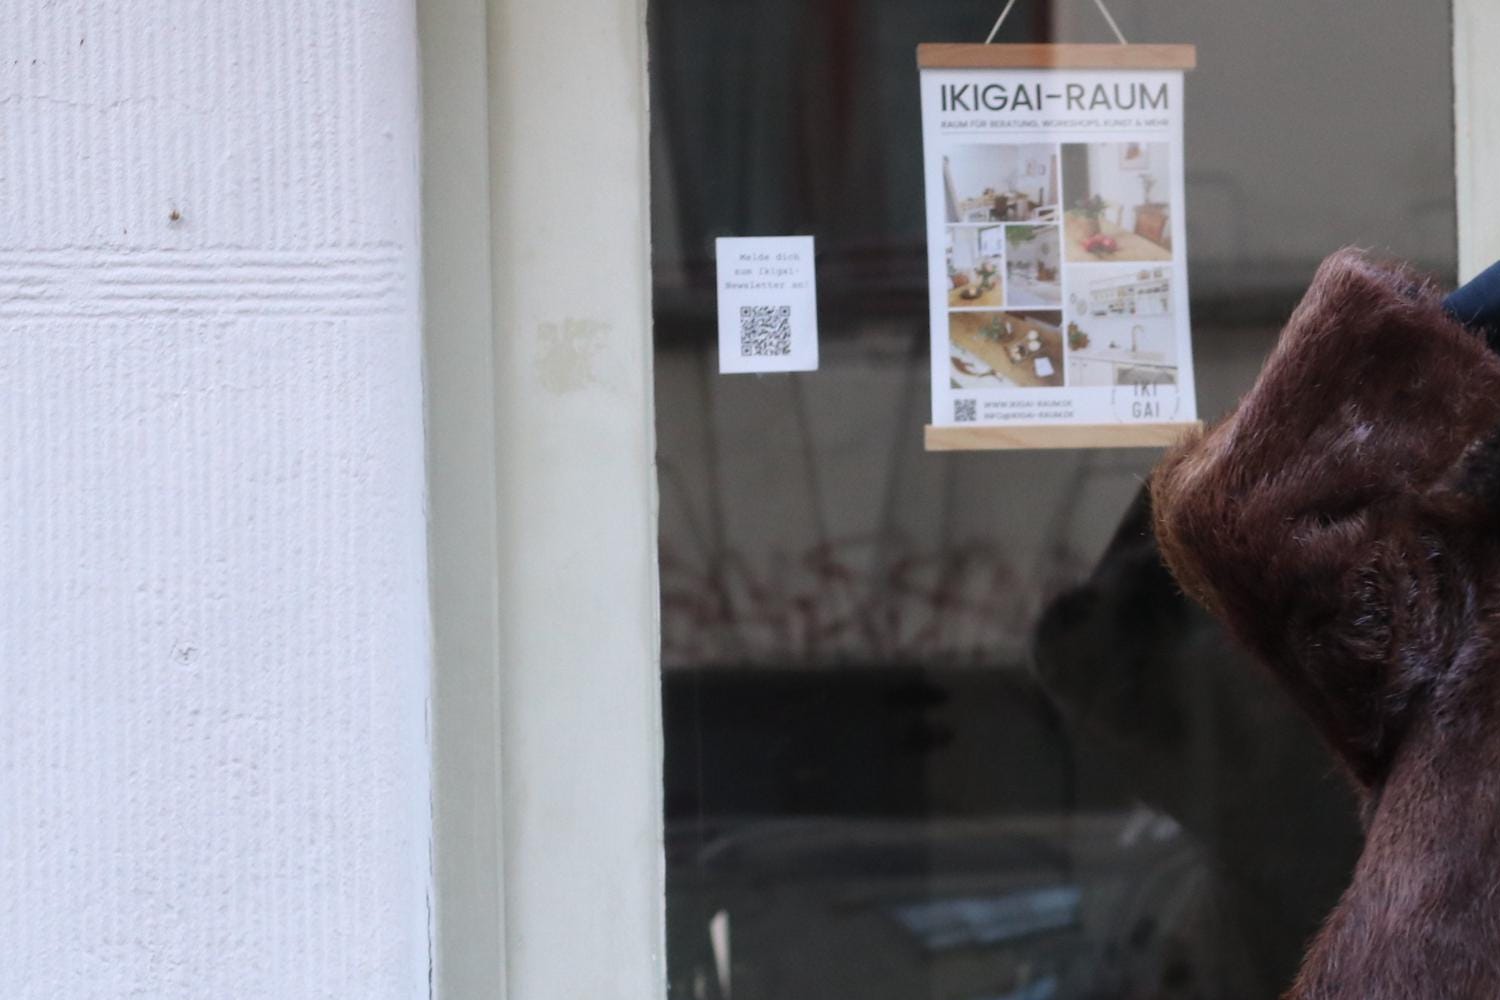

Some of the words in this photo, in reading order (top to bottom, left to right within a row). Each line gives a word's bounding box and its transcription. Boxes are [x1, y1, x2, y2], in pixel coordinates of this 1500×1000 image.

[941, 84, 1168, 111] IKIGAI-RAUM
[725, 281, 784, 290] Newsletter
[1133, 380, 1157, 397] IKI
[1132, 401, 1159, 418] GAI
